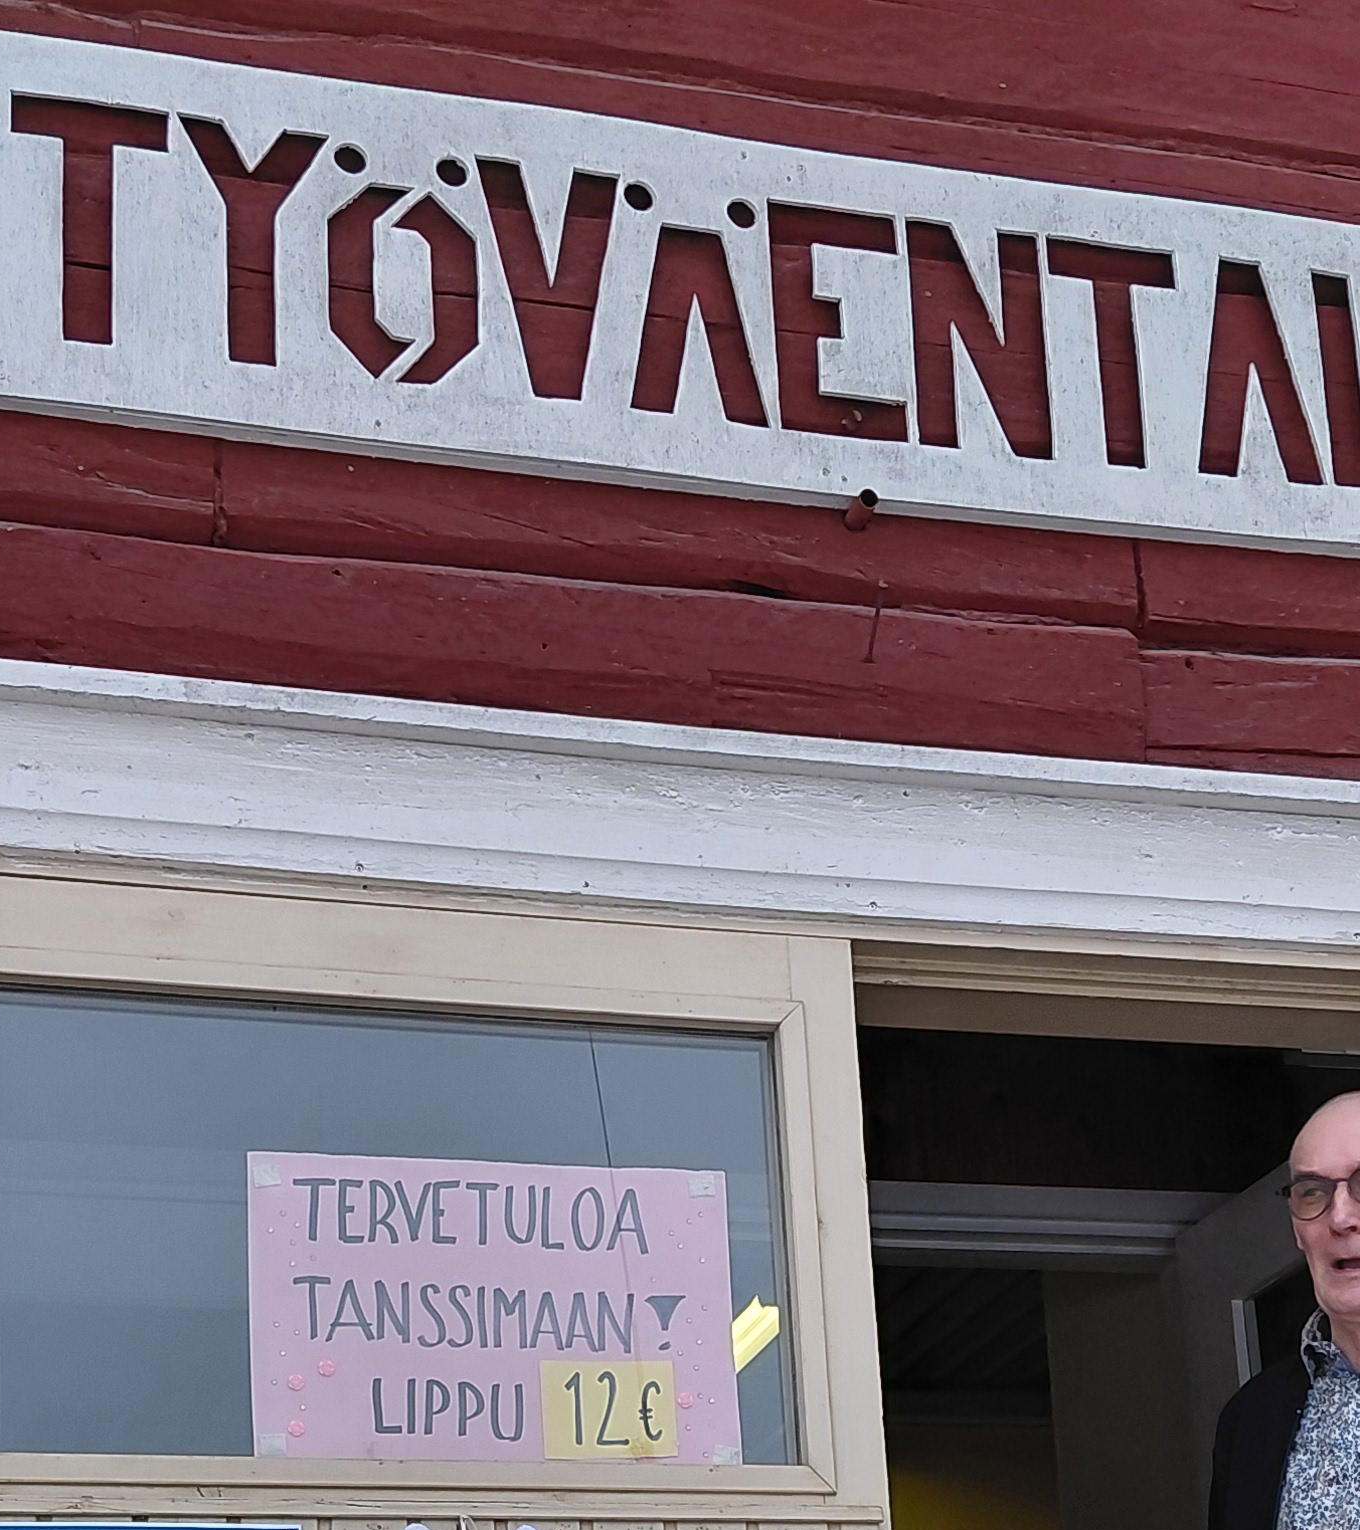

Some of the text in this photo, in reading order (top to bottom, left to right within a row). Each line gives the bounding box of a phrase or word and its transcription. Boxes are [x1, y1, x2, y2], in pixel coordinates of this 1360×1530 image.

[292, 1178, 649, 1255] TERVETULOA
[293, 1276, 686, 1353] TANSSIMAAN!
[371, 1378, 524, 1441] LIPPU
